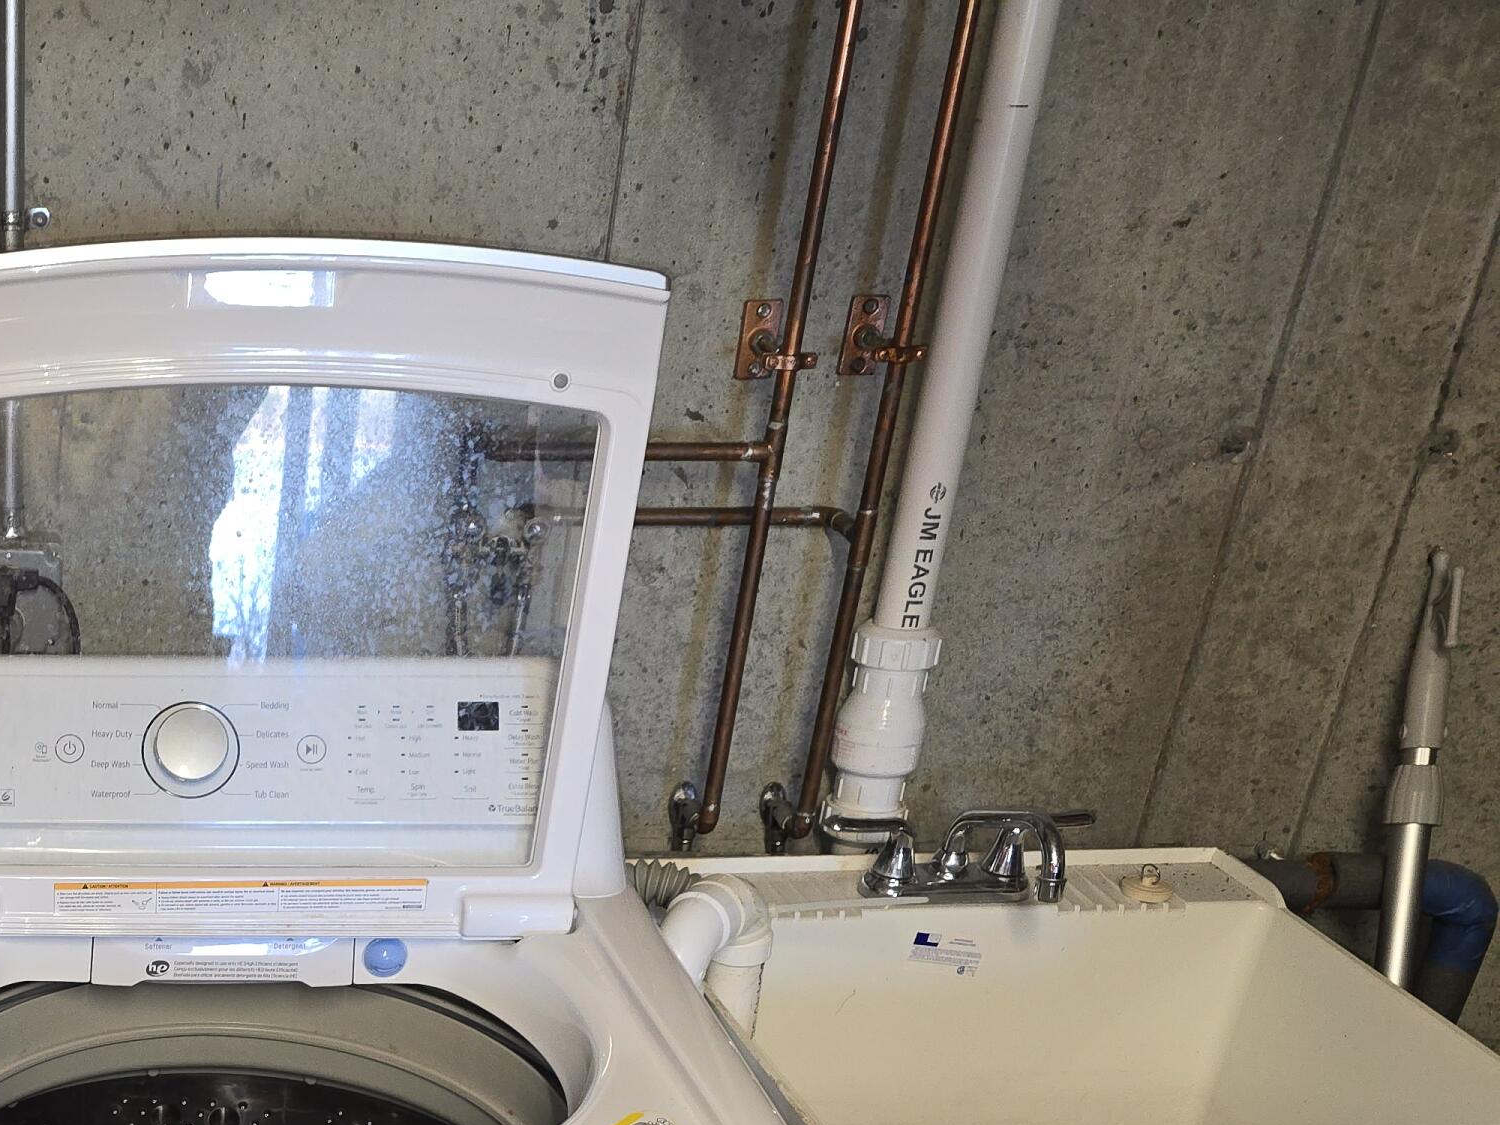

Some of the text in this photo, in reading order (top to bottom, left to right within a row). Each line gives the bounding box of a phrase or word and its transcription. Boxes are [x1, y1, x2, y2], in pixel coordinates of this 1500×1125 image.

[900, 506, 942, 629] JM EAGLE
[92, 701, 119, 709] Normal
[260, 701, 290, 711] Bedding
[91, 729, 133, 740] Heavy Duty
[255, 729, 289, 738] Delicates
[90, 760, 131, 770] Deep Wash
[245, 760, 290, 770] Speed Wash
[91, 790, 132, 799] Waterproof
[254, 790, 290, 799] Tub Clean
[497, 804, 539, 813] TrueBalan
[144, 942, 173, 951] Softener
[273, 942, 307, 951] Detergent
[146, 960, 170, 977] he
